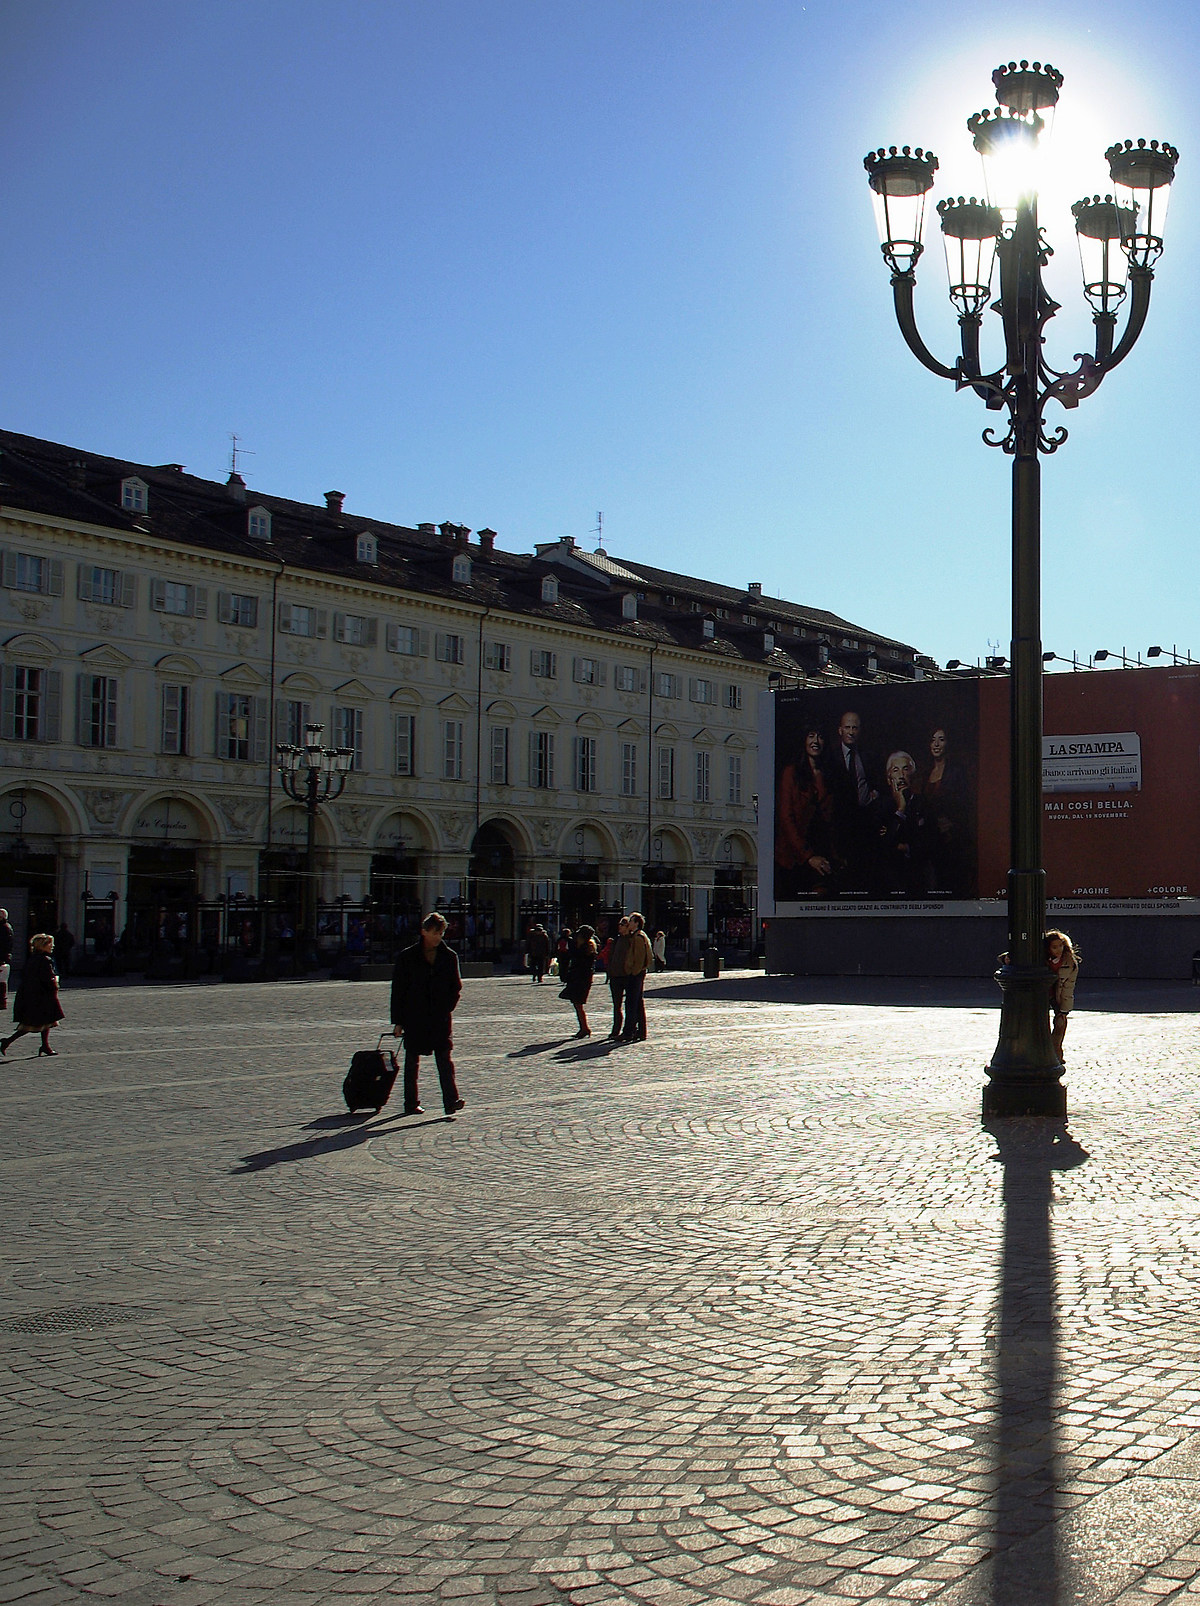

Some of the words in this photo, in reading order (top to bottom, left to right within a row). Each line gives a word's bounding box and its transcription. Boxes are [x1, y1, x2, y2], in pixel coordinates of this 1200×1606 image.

[1049, 744, 1068, 756] LA
[1068, 742, 1125, 755] STAMPA
[1066, 767, 1099, 776] arrivano
[1110, 765, 1137, 775] italiani
[1044, 802, 1064, 811] MAI
[1068, 800, 1093, 810] COSÌ
[1097, 800, 1133, 810] BELLA.
[1072, 887, 1110, 895] +PAGINE
[1147, 885, 1188, 895] +COLORE
